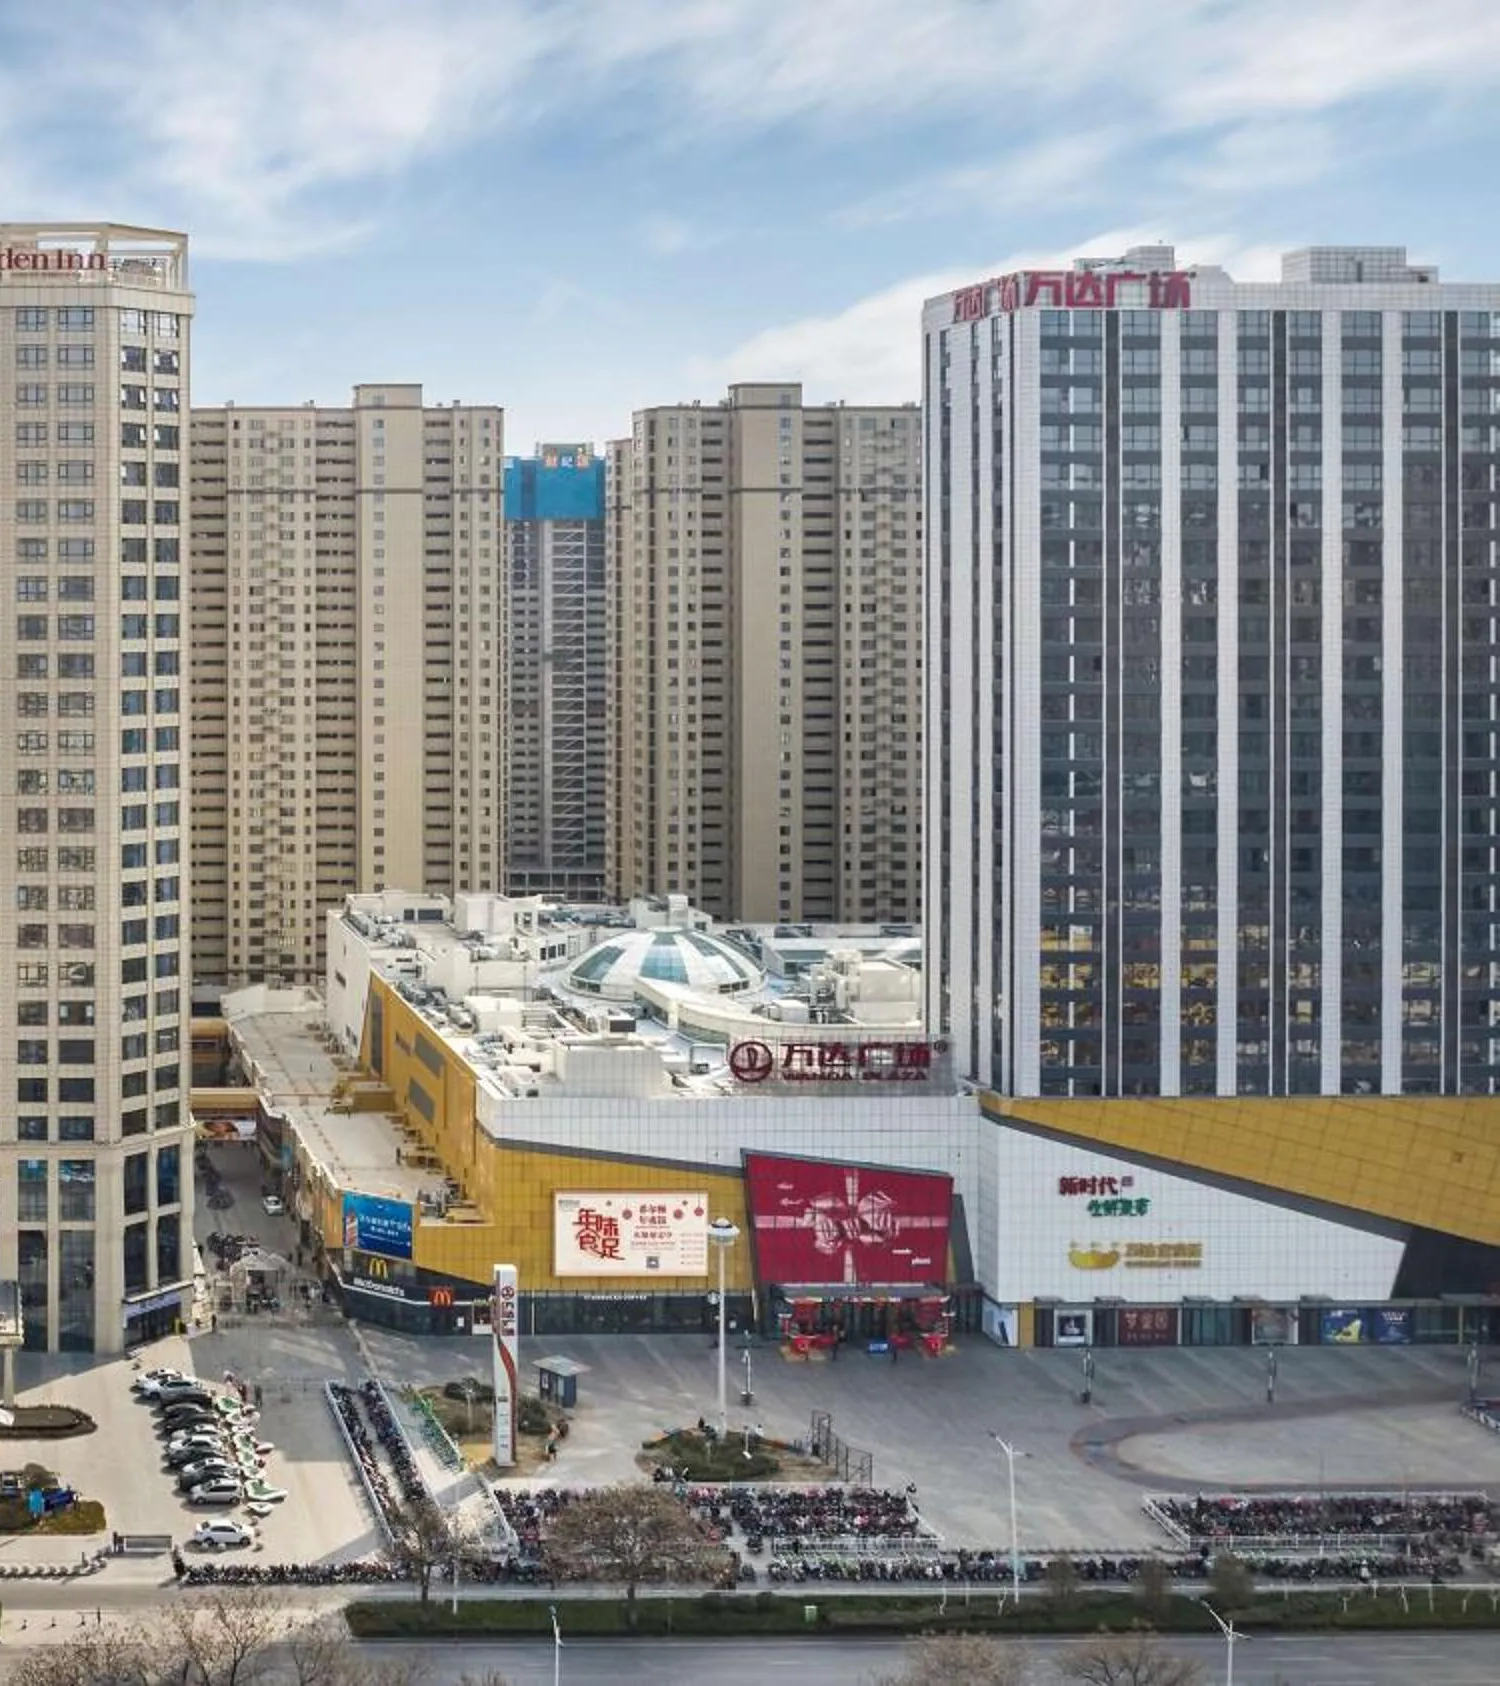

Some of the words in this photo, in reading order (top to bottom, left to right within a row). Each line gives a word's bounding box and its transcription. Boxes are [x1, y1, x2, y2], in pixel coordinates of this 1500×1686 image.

[56, 249, 109, 271] Inn
[1023, 271, 1191, 309] 万达广场
[780, 1042, 930, 1067] 万达广场
[862, 1071, 929, 1081] PLAZA
[1059, 1176, 1118, 1195] 新时代
